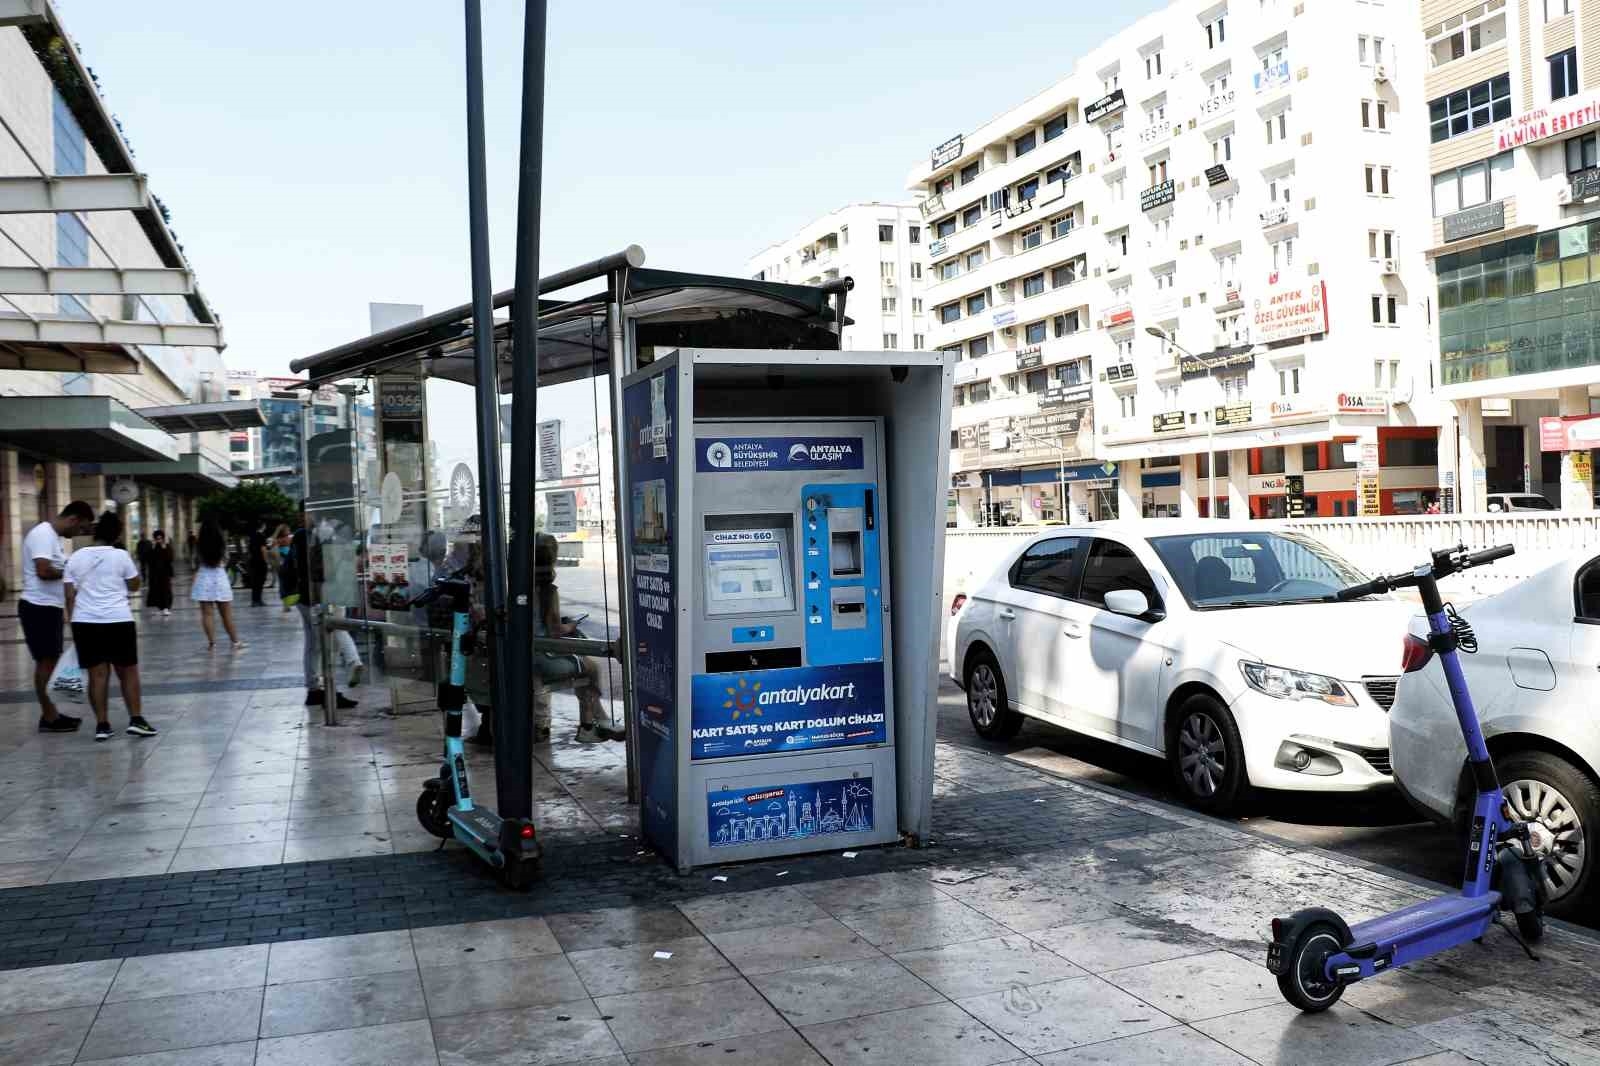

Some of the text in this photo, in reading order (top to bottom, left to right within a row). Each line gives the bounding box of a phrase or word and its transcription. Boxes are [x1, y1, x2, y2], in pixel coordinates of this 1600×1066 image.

[1551, 100, 1600, 132] ESTETİ
[810, 445, 852, 454] ANTALYA
[733, 450, 779, 460] BÜYÜKŞEHİR
[810, 453, 842, 462] ULAŞIM
[1262, 480, 1275, 489] ING
[753, 532, 772, 540] 660
[758, 682, 855, 706] antalyakart
[693, 713, 884, 739] KART SATIŞ ve KART DOLUM CİHAZI
